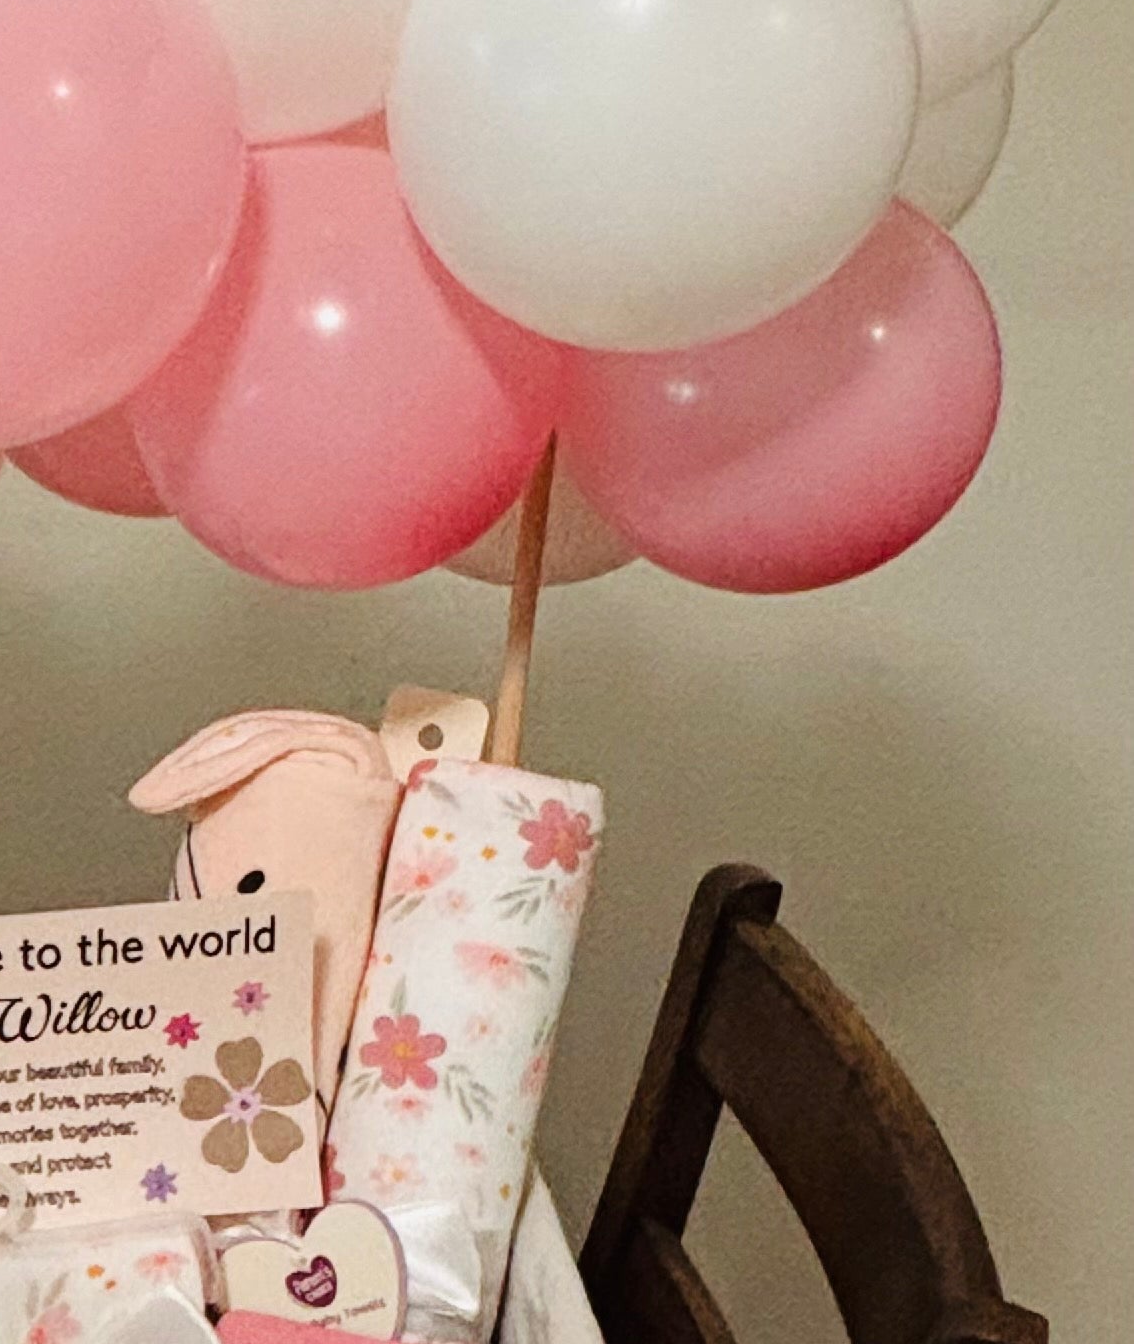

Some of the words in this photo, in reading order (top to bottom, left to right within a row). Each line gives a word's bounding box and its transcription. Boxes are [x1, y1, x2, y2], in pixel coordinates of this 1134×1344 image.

[20, 938, 61, 973] to
[78, 929, 144, 965] the
[159, 915, 276, 960] world
[26, 1058, 104, 1081] beautiful
[16, 1092, 35, 1112] of
[47, 1152, 112, 1176] protect
